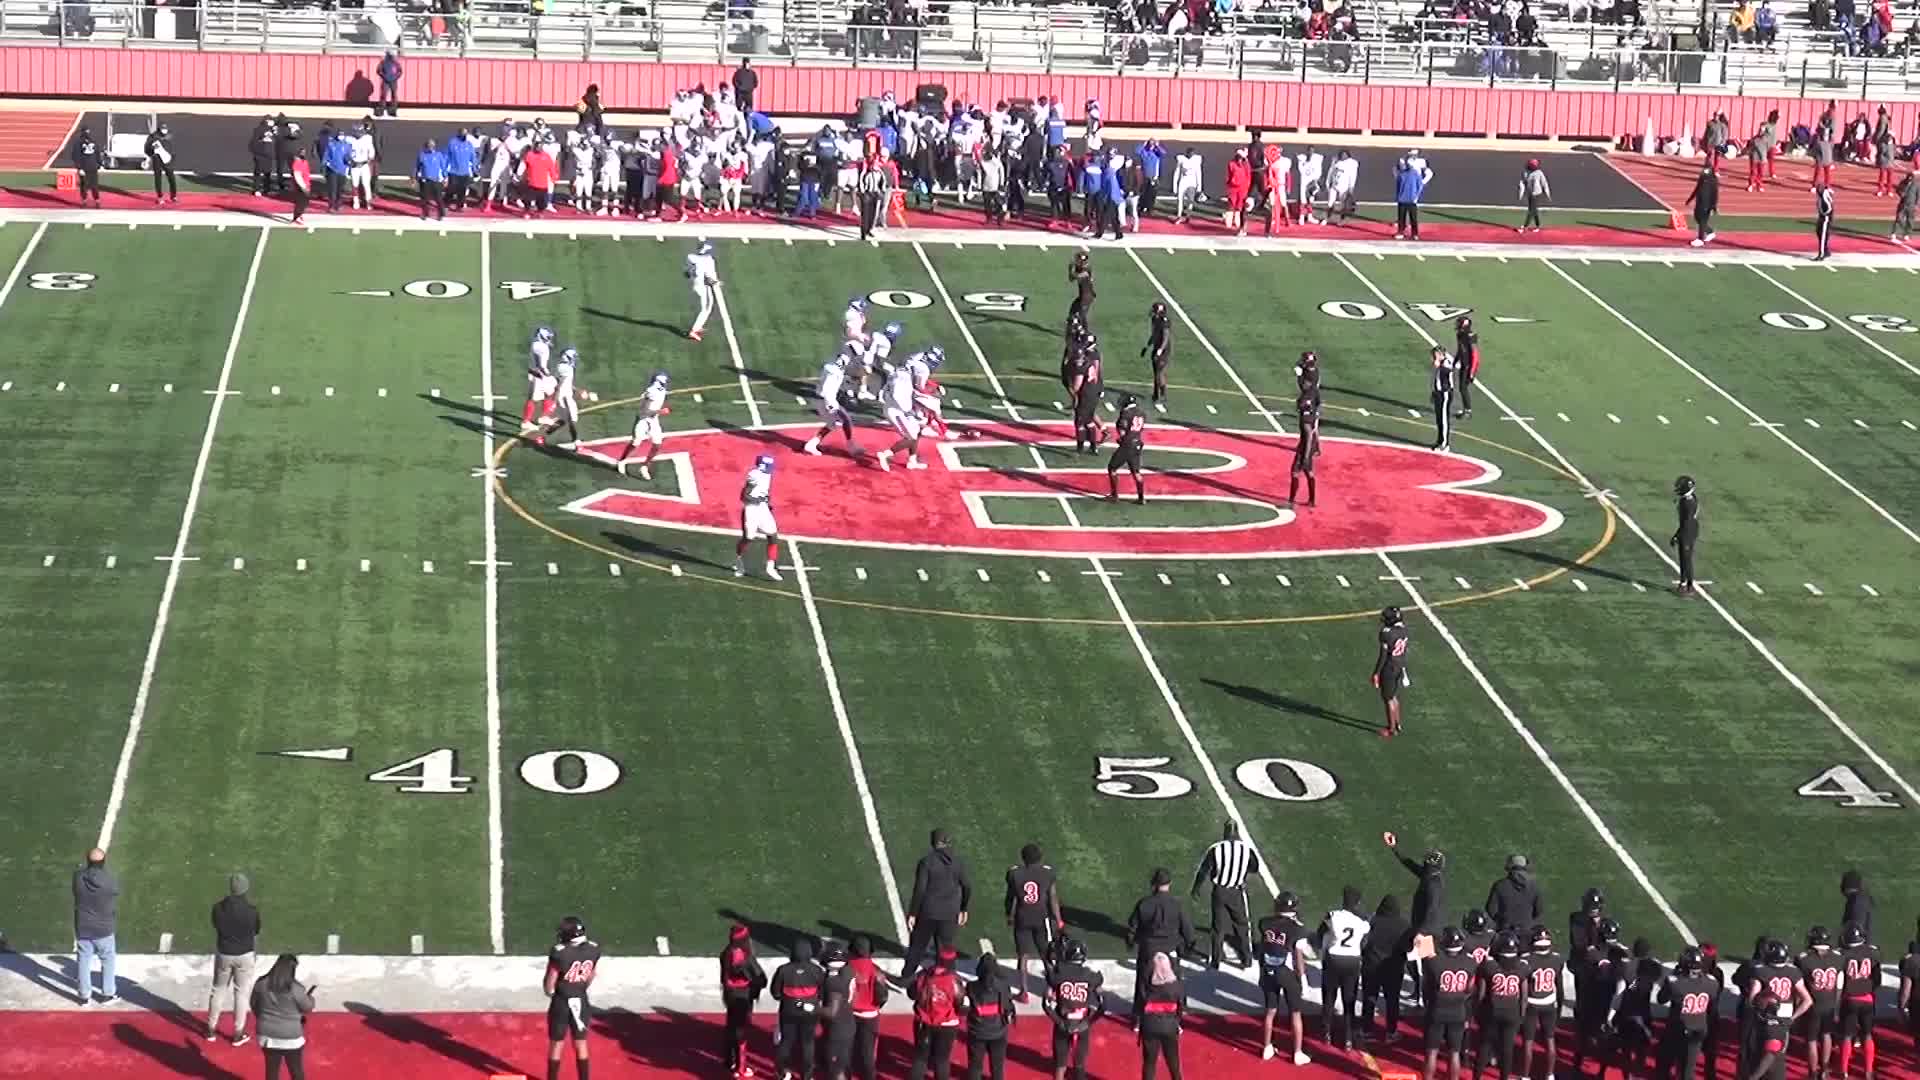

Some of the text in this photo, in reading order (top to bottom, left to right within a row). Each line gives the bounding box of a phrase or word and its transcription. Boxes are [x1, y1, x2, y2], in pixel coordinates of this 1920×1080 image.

[1023, 881, 1039, 904] 3
[1340, 927, 1354, 947] 2
[1492, 973, 1519, 996] 26
